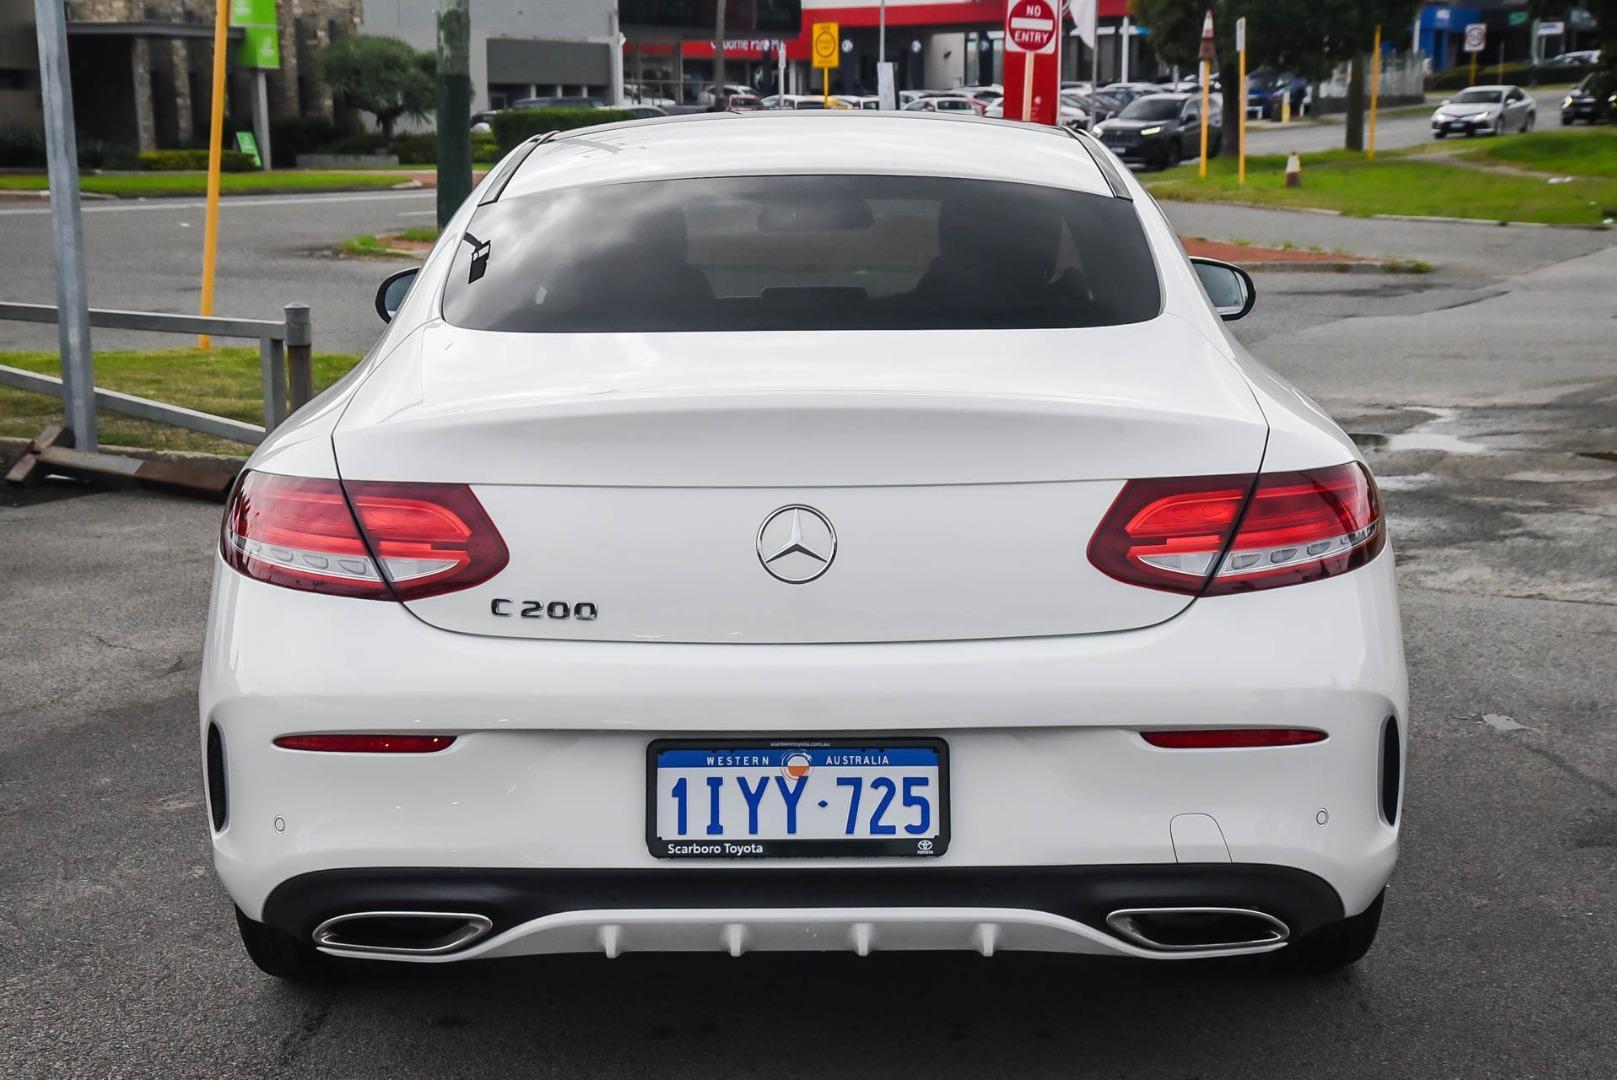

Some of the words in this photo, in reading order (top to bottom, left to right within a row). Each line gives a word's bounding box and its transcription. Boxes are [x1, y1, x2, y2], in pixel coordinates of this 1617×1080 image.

[1026, 5, 1042, 17] NO
[1014, 31, 1050, 44] ENTRY
[490, 598, 513, 617] C
[520, 600, 598, 621] 200
[706, 756, 770, 766] WESTERN
[825, 755, 890, 766] AUSTRALIA
[667, 843, 723, 855] Scarboro
[724, 843, 764, 856] Toyota
